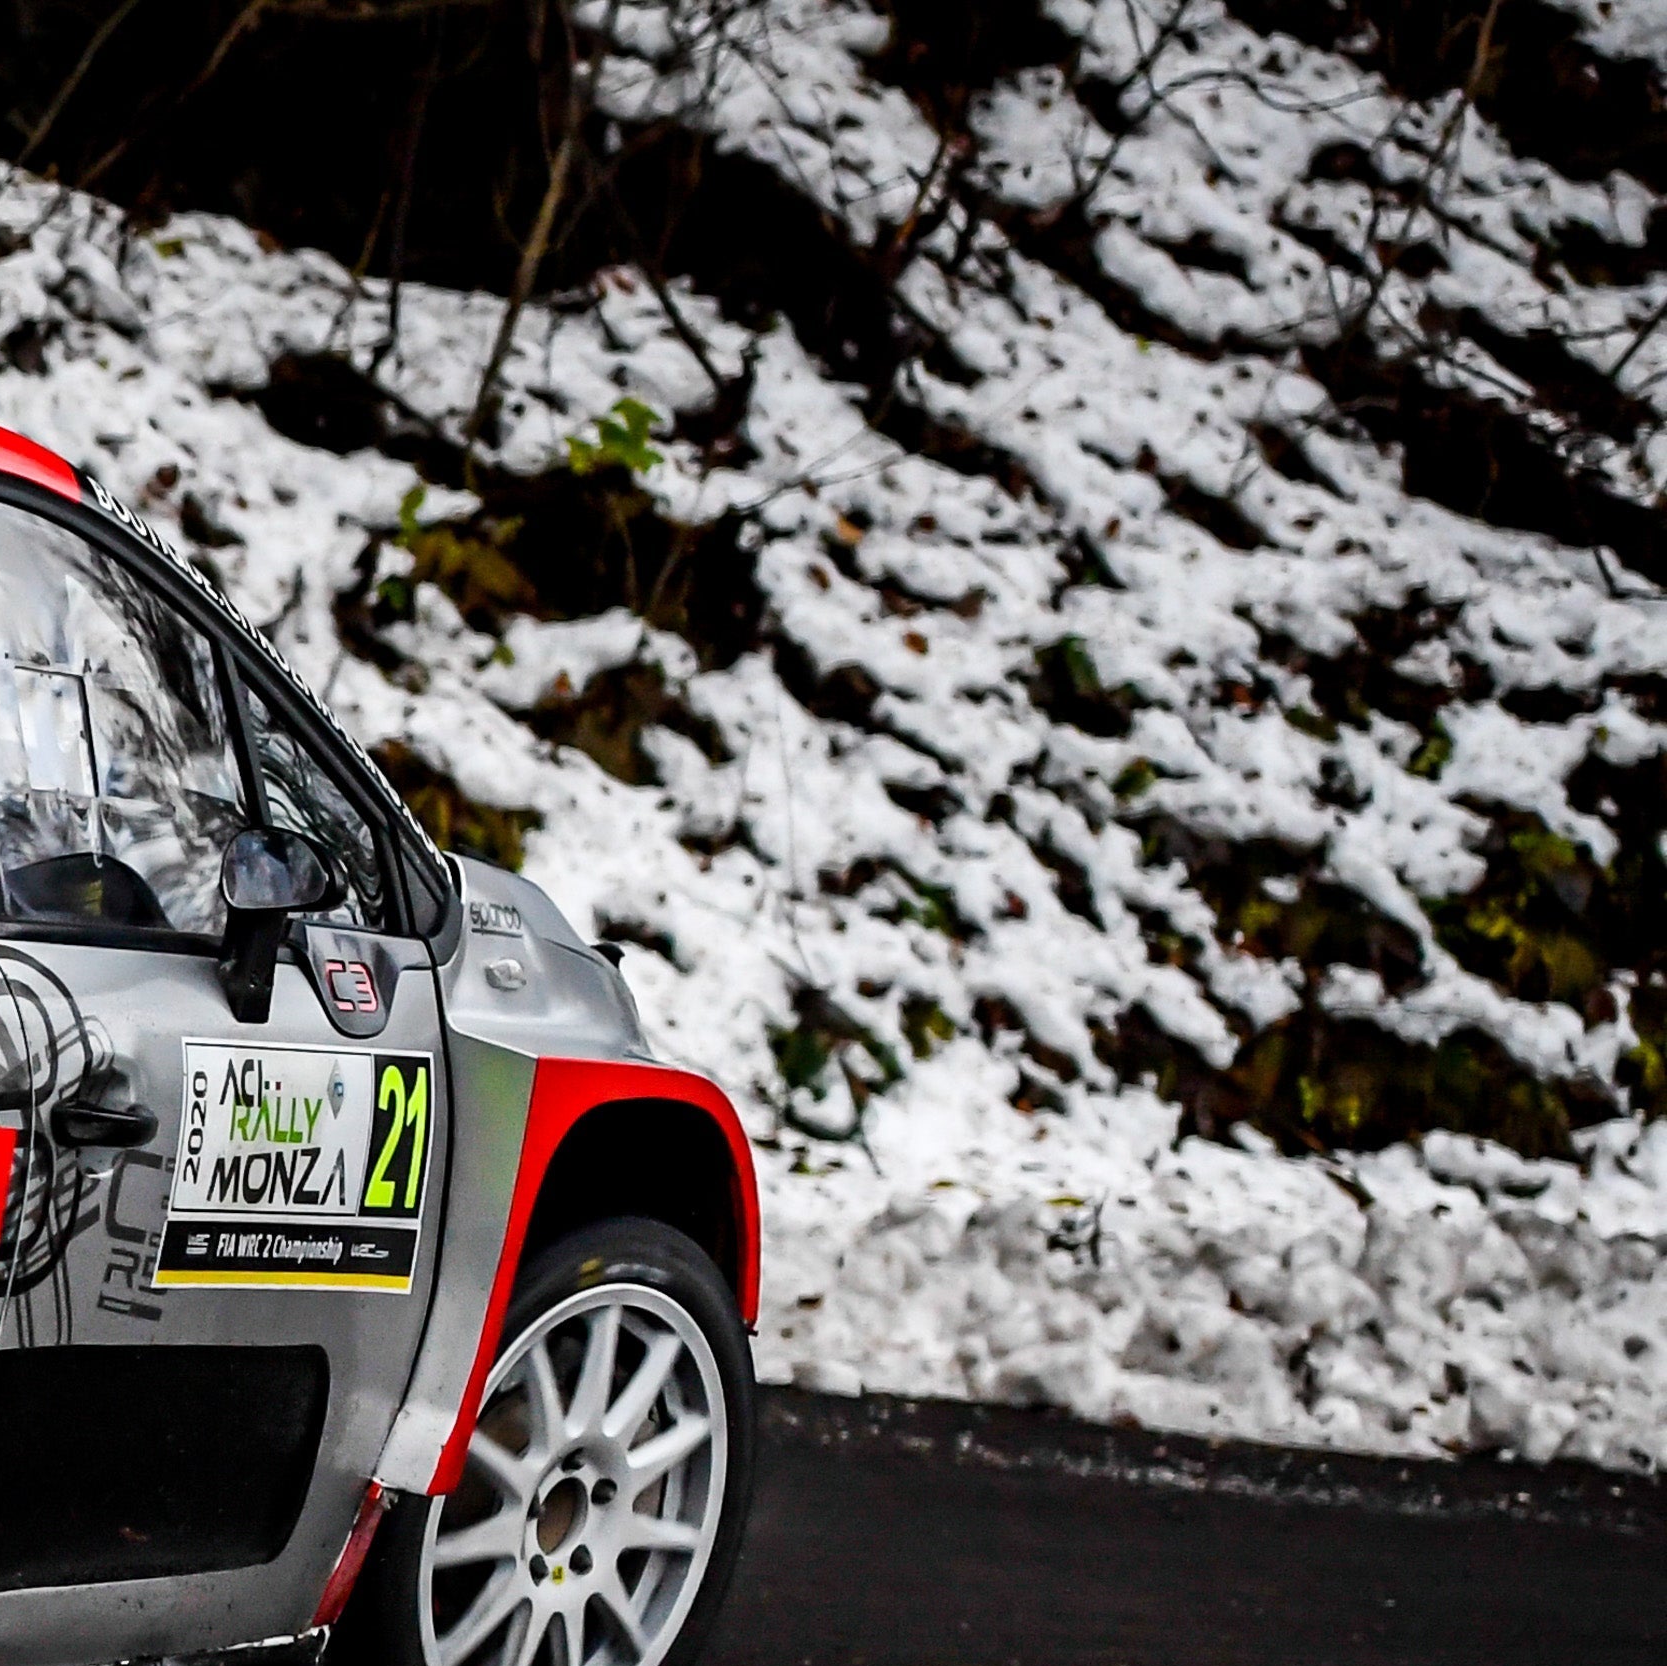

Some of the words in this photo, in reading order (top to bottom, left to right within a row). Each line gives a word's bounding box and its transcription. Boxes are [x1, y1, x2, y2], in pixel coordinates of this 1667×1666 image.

[325, 960, 379, 1013] C3
[219, 1058, 263, 1107] ACI
[183, 1070, 208, 1184] 2020
[229, 1096, 323, 1144] RALLY
[364, 1064, 428, 1209] 21
[206, 1146, 346, 1207] MONZA
[216, 1233, 236, 1257] FIA
[237, 1233, 264, 1257] WRC
[262, 1234, 273, 1258] 2
[272, 1234, 343, 1266] Championship
